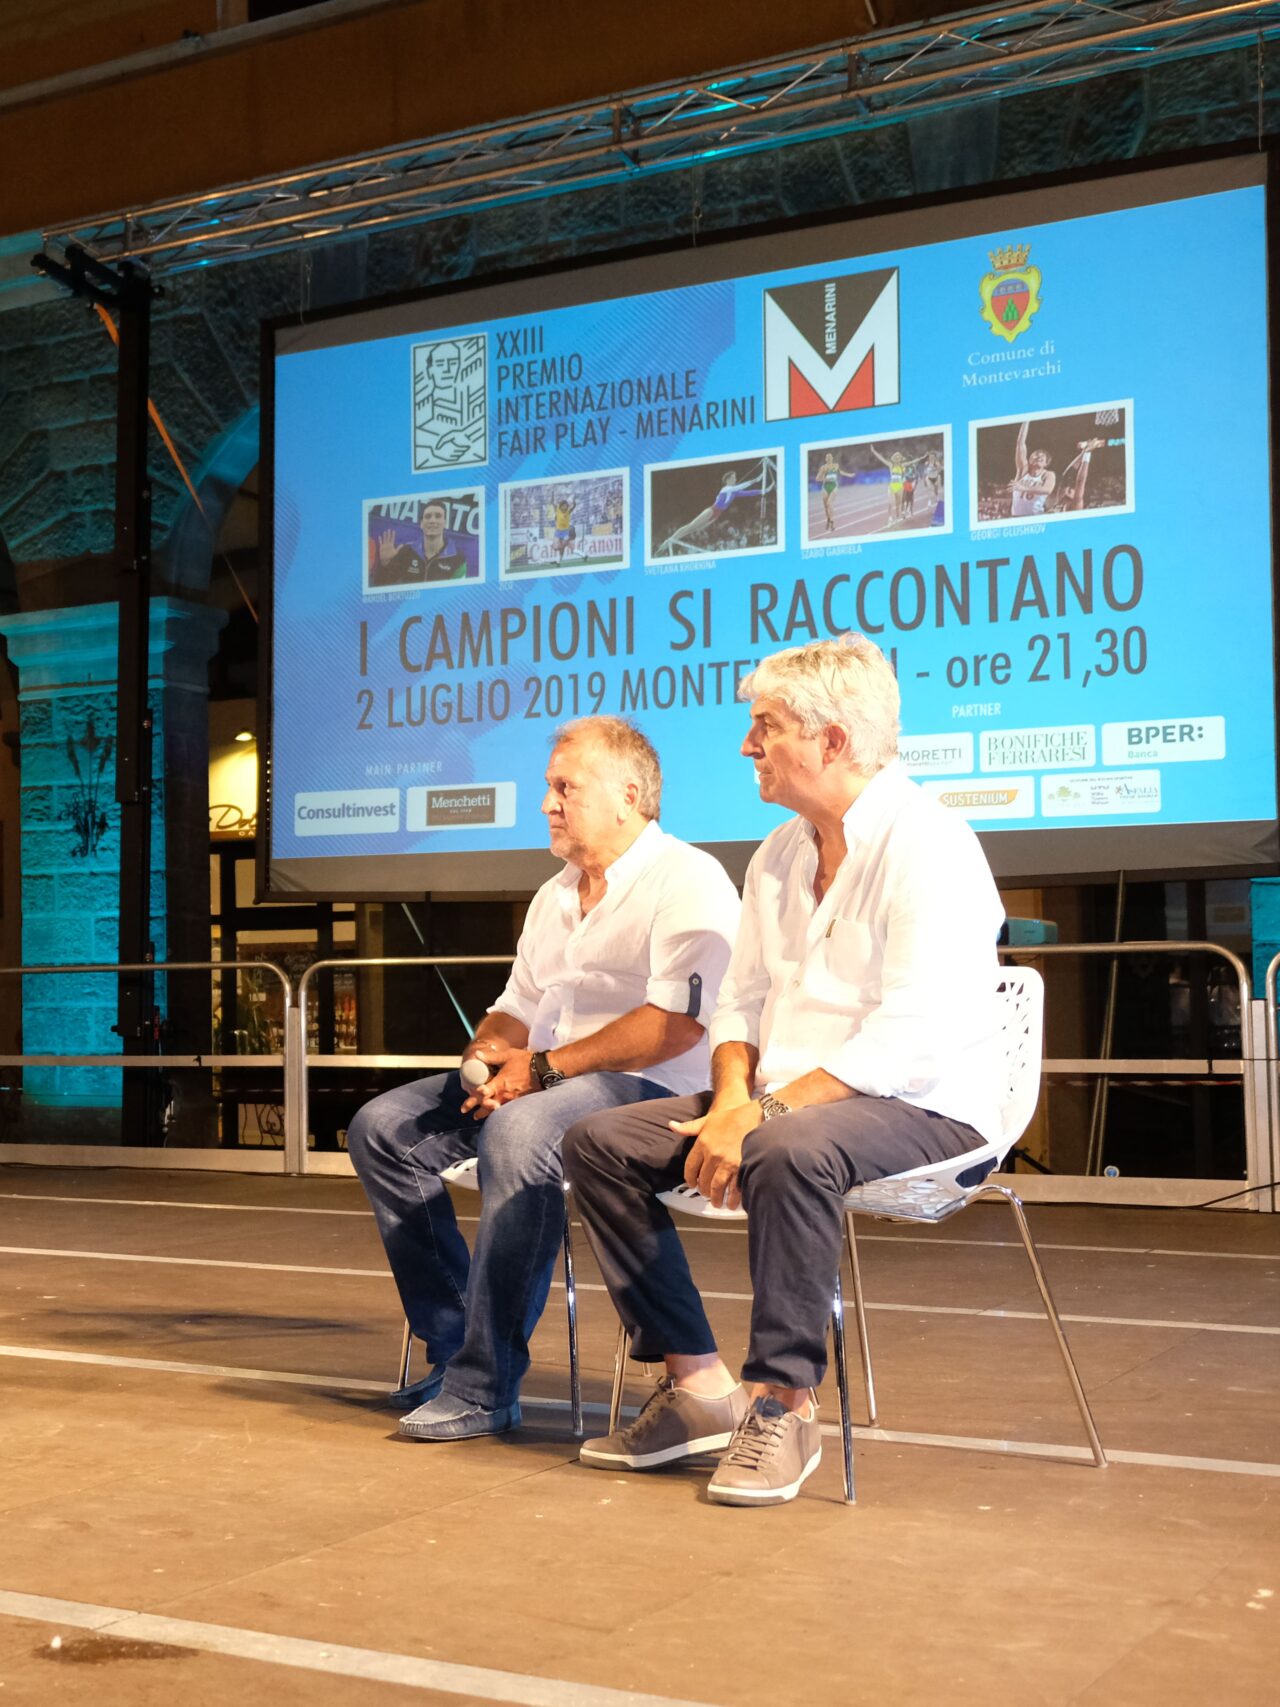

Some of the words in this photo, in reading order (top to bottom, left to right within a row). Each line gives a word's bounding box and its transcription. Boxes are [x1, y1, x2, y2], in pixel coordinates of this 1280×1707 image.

[825, 283, 836, 355] MENARINI
[496, 326, 545, 360] XXIII
[967, 345, 1035, 367] Comune
[1039, 340, 1056, 357] di
[497, 354, 584, 392] PREMIO
[961, 360, 1062, 388] Montevarchi
[497, 369, 697, 426] INTERNAZIONALE
[497, 427, 547, 458] FAIR
[555, 418, 610, 452] PLAY
[636, 396, 756, 440] MENARINI
[359, 620, 368, 677] I
[398, 596, 635, 673] CAMPIONI
[668, 588, 712, 652] SI
[750, 544, 1144, 645] RACCONTANO
[356, 689, 375, 730] 2
[387, 679, 510, 728] LUGLIO
[524, 671, 606, 719] 2019
[946, 651, 1012, 688] ore
[1027, 626, 1148, 688] 21,30
[951, 703, 1002, 718] PARTNER
[988, 731, 1088, 751] BONIFICHE
[365, 764, 392, 775] MAIN
[396, 761, 443, 774] PARTNER
[988, 747, 1086, 766] FERRARESI
[1127, 750, 1159, 760] Banca
[297, 802, 397, 820] Consultinvest
[431, 794, 490, 809] Menchetti
[942, 791, 1009, 807] SUSTENIUM
